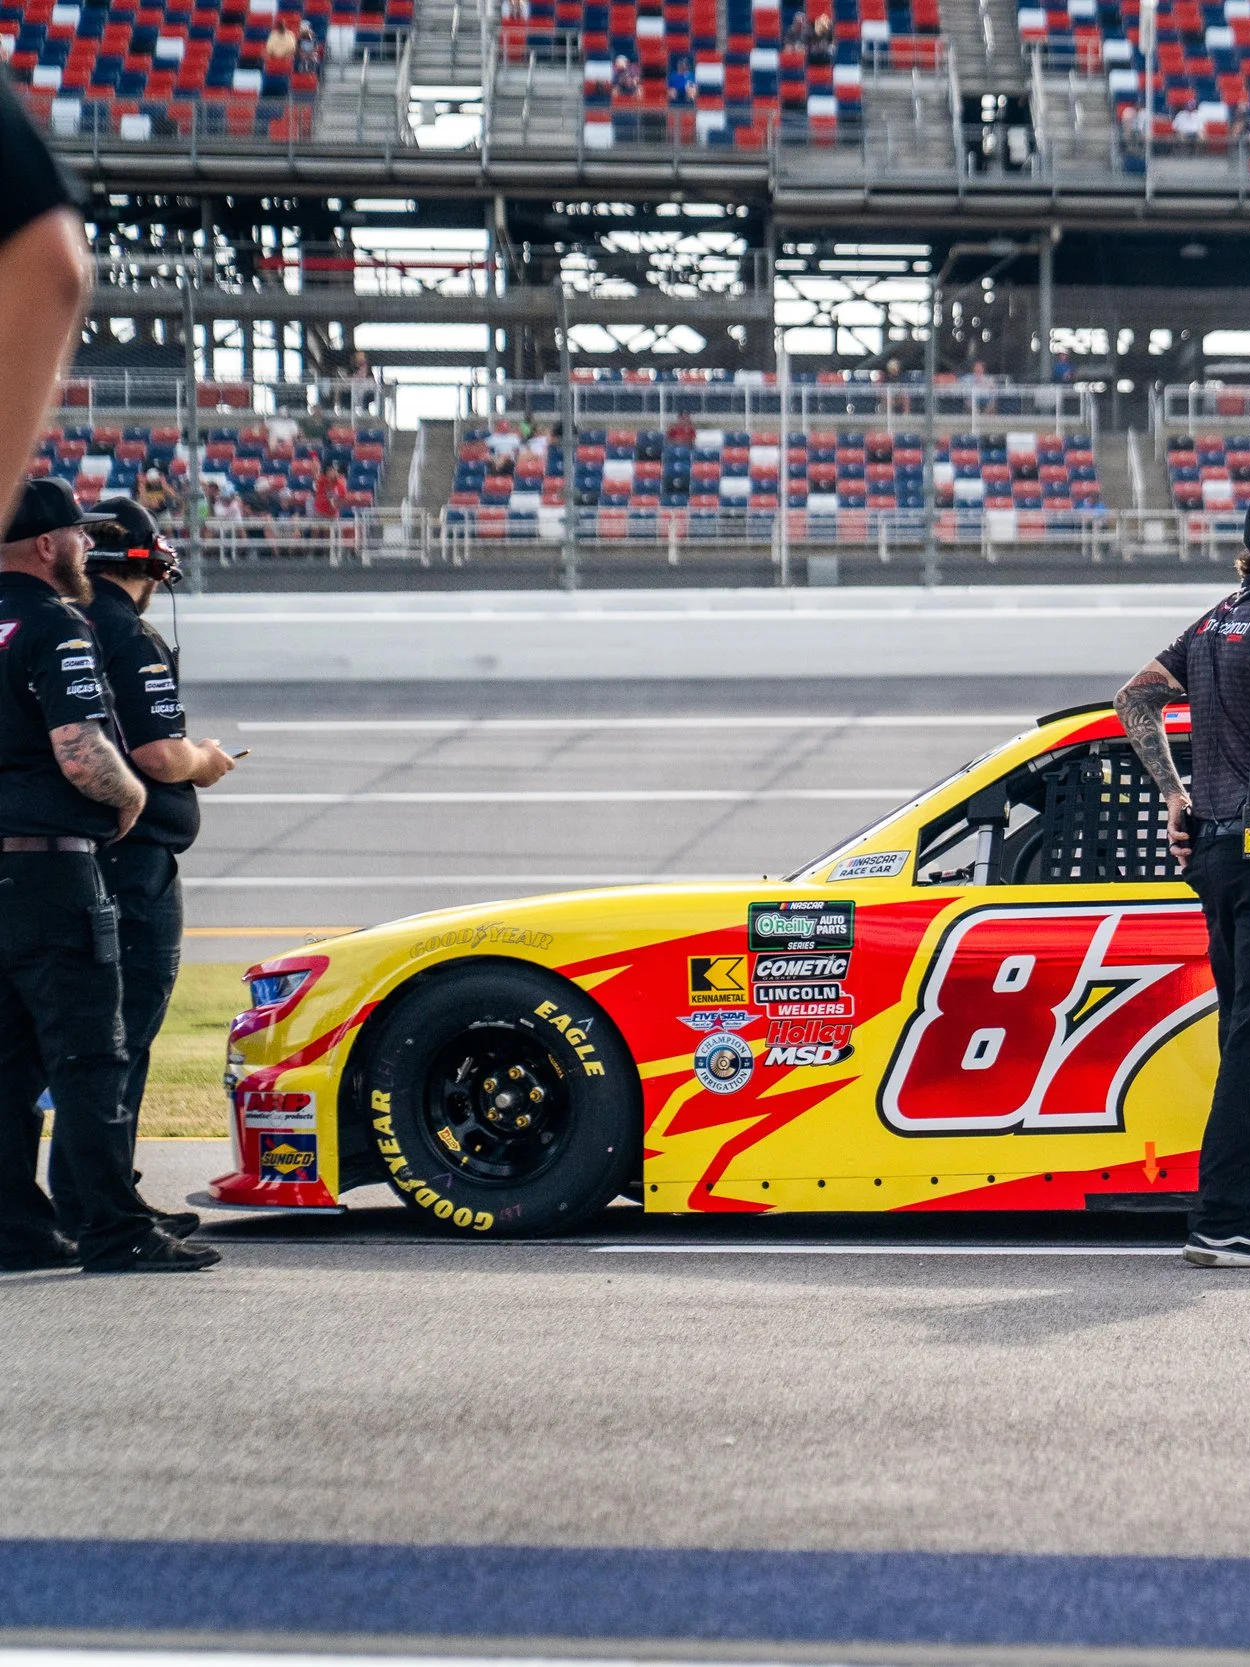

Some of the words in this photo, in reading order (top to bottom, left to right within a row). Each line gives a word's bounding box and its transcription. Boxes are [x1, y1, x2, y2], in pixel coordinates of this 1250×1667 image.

[67, 683, 95, 695] LUCAS
[151, 702, 174, 714] LUCAS
[856, 854, 897, 866] NASCAR
[840, 867, 866, 877] RACE
[869, 865, 891, 874] CAR
[790, 902, 825, 910] NASCAR
[758, 914, 816, 937] O'Reilly
[819, 915, 844, 925] AUTO
[816, 925, 847, 935] PARTS
[409, 925, 553, 958] GOODYEAR
[787, 941, 815, 950] SERIES
[756, 956, 846, 977] COMETIC
[691, 993, 746, 1003] KENNAMETAL
[759, 986, 836, 1001] LINCOLN
[693, 1012, 717, 1021] FIVE
[720, 1012, 746, 1021] STAR
[778, 1004, 845, 1016] WELDERS
[882, 904, 1217, 1131] 87
[533, 1000, 605, 1077] EAGLE
[766, 1020, 853, 1050] Holley
[701, 1036, 747, 1054] CHAMPION
[764, 1046, 840, 1066] MSD
[700, 1071, 748, 1091] IRRIGATION
[262, 1153, 314, 1165] SUNOCO
[371, 1089, 494, 1231] GOODYEAR
